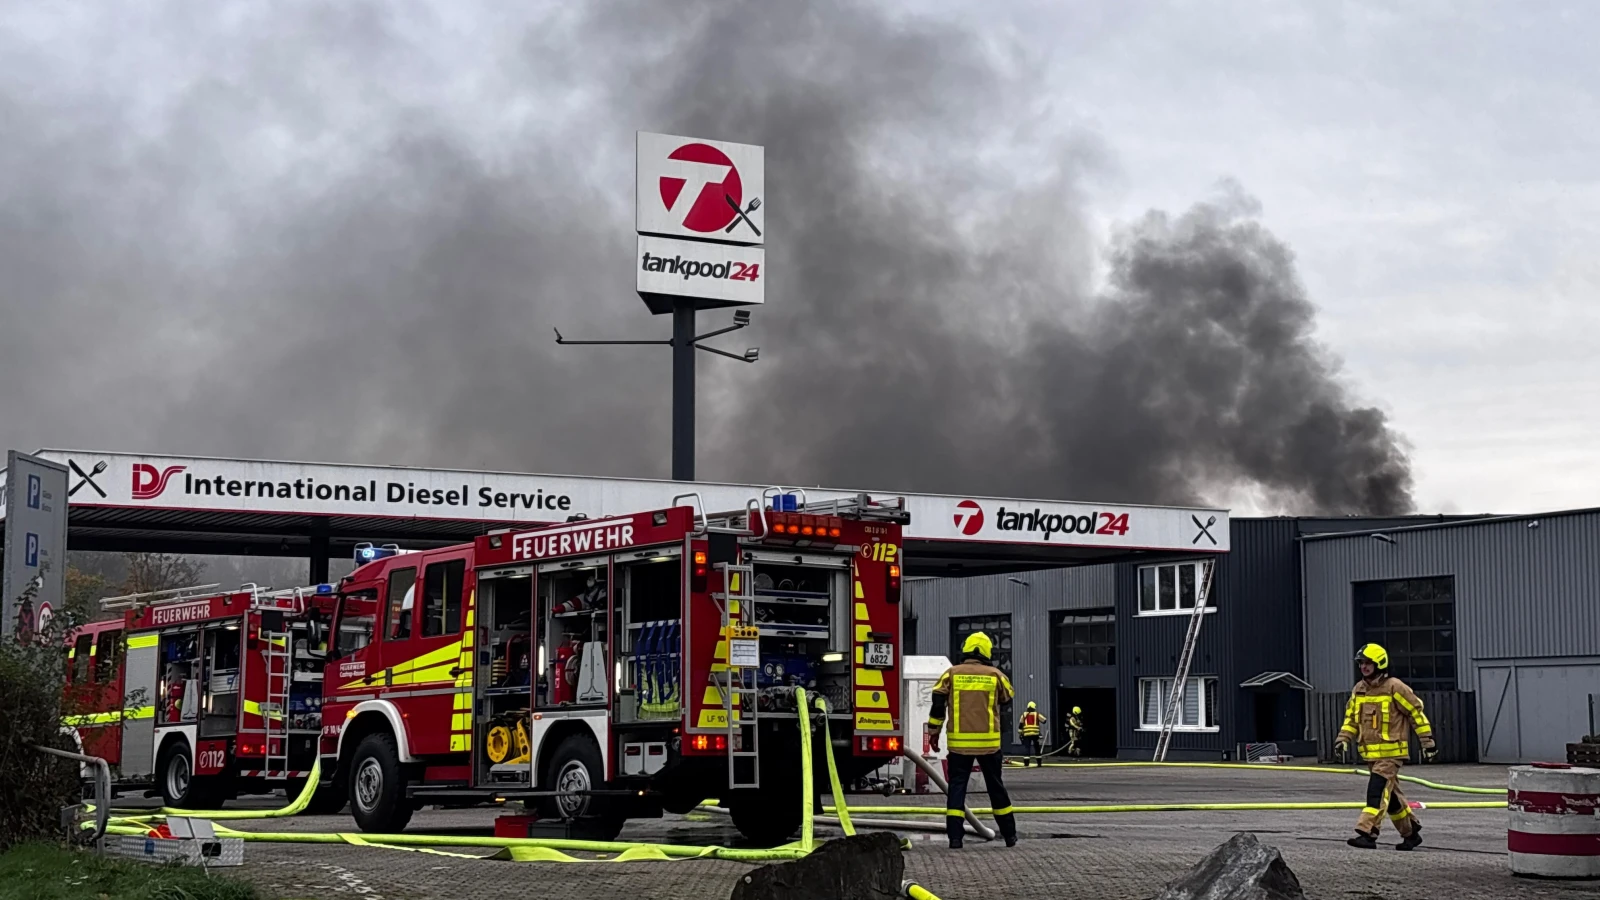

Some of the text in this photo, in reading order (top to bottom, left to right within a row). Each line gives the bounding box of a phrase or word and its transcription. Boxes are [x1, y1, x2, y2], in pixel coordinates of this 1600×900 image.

[642, 252, 760, 282] tankpool24
[29, 477, 39, 506] P
[185, 473, 571, 510] International Diesel Service
[996, 506, 1130, 541] tankpool24
[28, 535, 37, 564] P
[512, 517, 634, 560] FEUERWEHR
[872, 543, 898, 562] 112
[152, 600, 211, 625] FEUERWEHR
[870, 654, 888, 664] 6822
[873, 644, 884, 654] RE
[707, 715, 716, 723] LF
[208, 750, 225, 768] 112
